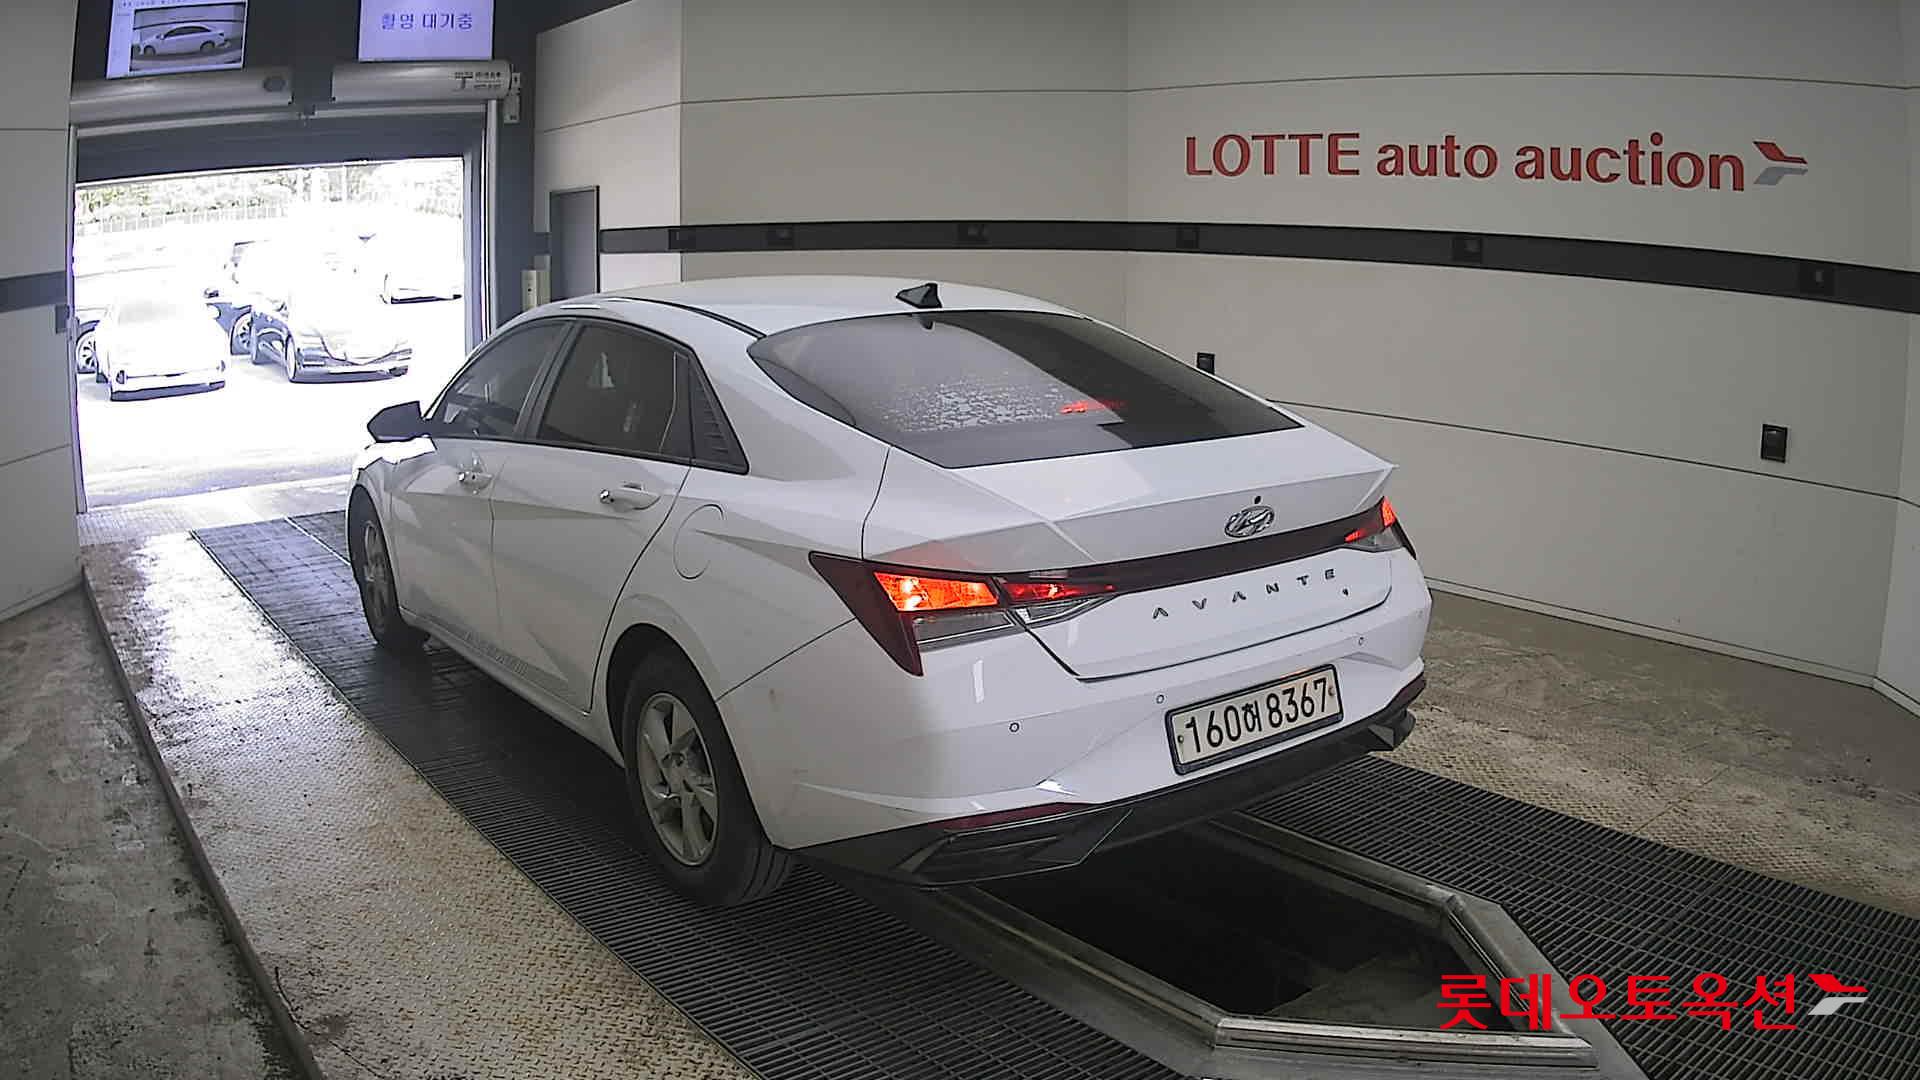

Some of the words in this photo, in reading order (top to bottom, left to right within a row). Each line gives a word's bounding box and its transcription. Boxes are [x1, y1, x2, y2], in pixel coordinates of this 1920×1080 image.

[422, 12, 473, 30] 대기중
[1185, 132, 1361, 177] LOTTE
[1376, 134, 1499, 178] auto
[1515, 131, 1745, 192] auction
[1152, 567, 1336, 620] AVANTE
[1185, 677, 1327, 753] 160허8367
